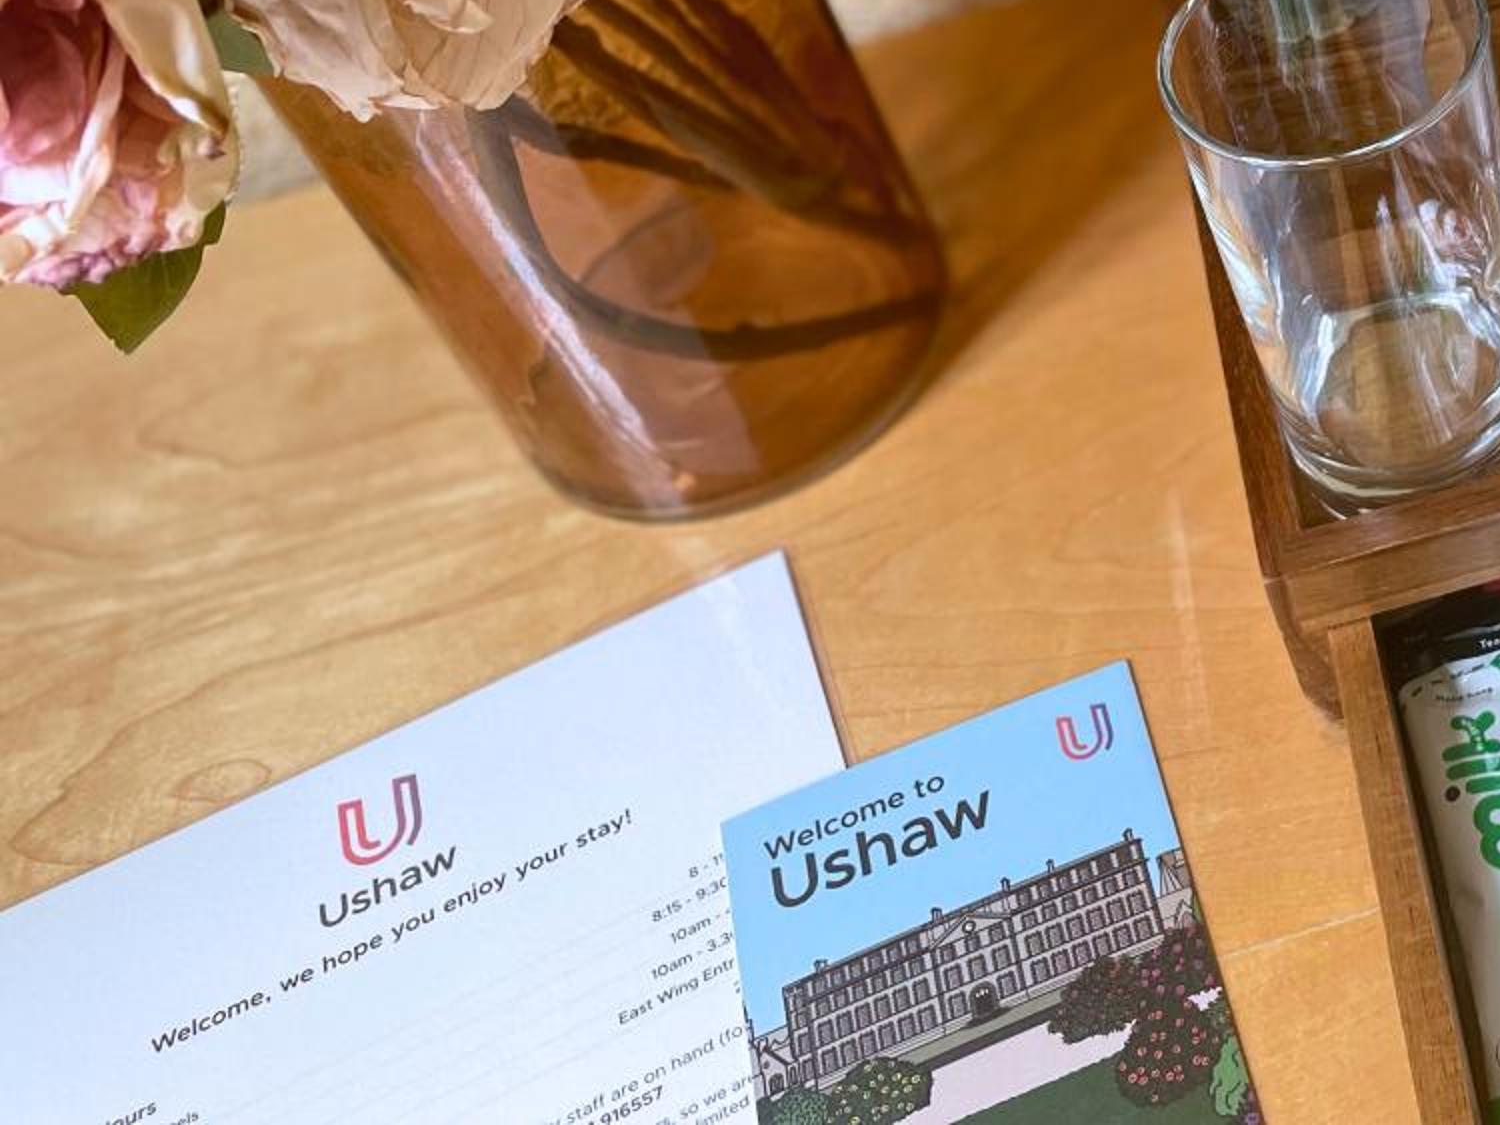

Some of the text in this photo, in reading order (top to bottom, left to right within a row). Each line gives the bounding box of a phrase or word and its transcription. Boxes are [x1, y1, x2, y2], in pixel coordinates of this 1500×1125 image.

[763, 775, 946, 860] Welcome to
[770, 790, 990, 908] Ushaw
[318, 846, 457, 928] Ushaw
[151, 808, 632, 1053] Welcome, we hope you enjoy your stay!
[651, 953, 694, 980] 10am
[706, 931, 733, 953] 3.3
[669, 916, 712, 944] 10am
[617, 957, 736, 1026] East Wing Entr
[566, 1092, 606, 1124] staff
[610, 1079, 640, 1103] are
[643, 1065, 667, 1085] on
[670, 1038, 716, 1071] hand
[718, 1025, 745, 1048] (fo
[600, 1085, 664, 1125] 916557
[679, 1101, 700, 1120] so
[702, 1087, 728, 1106] we
[732, 1075, 753, 1093] ar
[104, 1101, 158, 1125] ours
